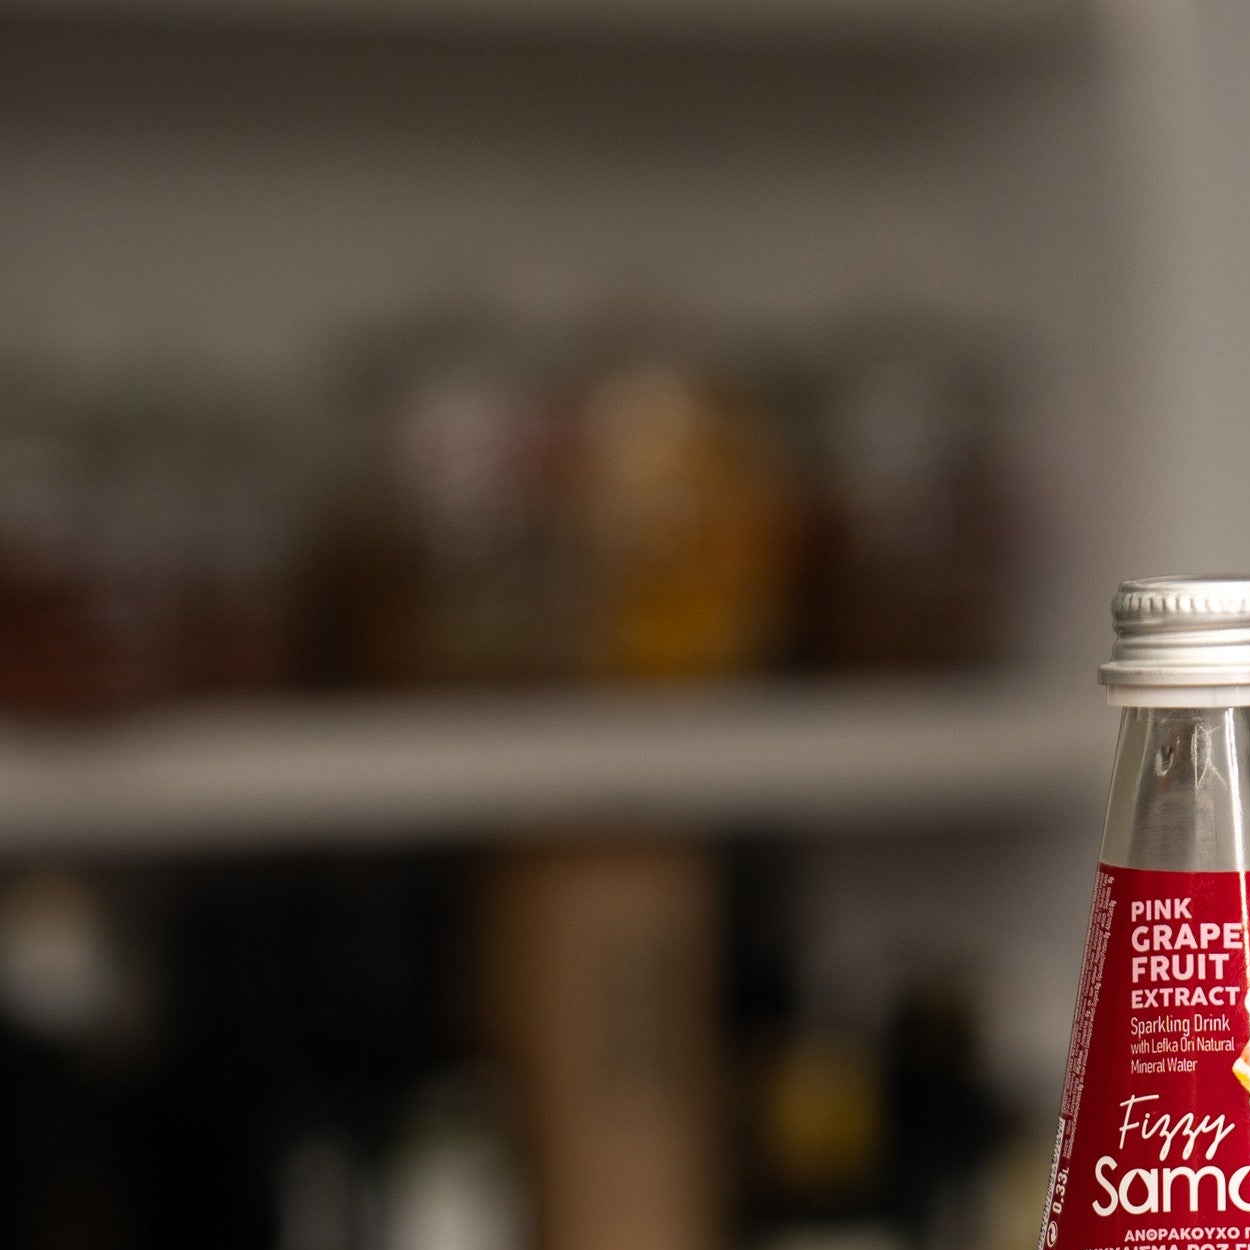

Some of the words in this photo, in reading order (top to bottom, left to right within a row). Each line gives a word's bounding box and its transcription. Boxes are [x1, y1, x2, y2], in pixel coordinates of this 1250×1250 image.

[1131, 897, 1193, 922] PINK
[1131, 922, 1244, 952] GRAPE
[1132, 953, 1231, 983] FRUIT
[1131, 986, 1241, 1009] EXTRACT
[1130, 1014, 1191, 1038] Sparkling
[1194, 1013, 1231, 1032] Drink
[1130, 1037, 1150, 1054] with
[1151, 1037, 1179, 1053] Lefka
[1180, 1036, 1196, 1052] Ori
[1197, 1036, 1235, 1052] Natural
[1130, 1058, 1166, 1074] Mineral
[1167, 1057, 1198, 1073] Water
[1119, 1094, 1236, 1162] Fizzy
[1124, 1226, 1240, 1242] ΑΝΘΡΑΚΟΥΧΟ
